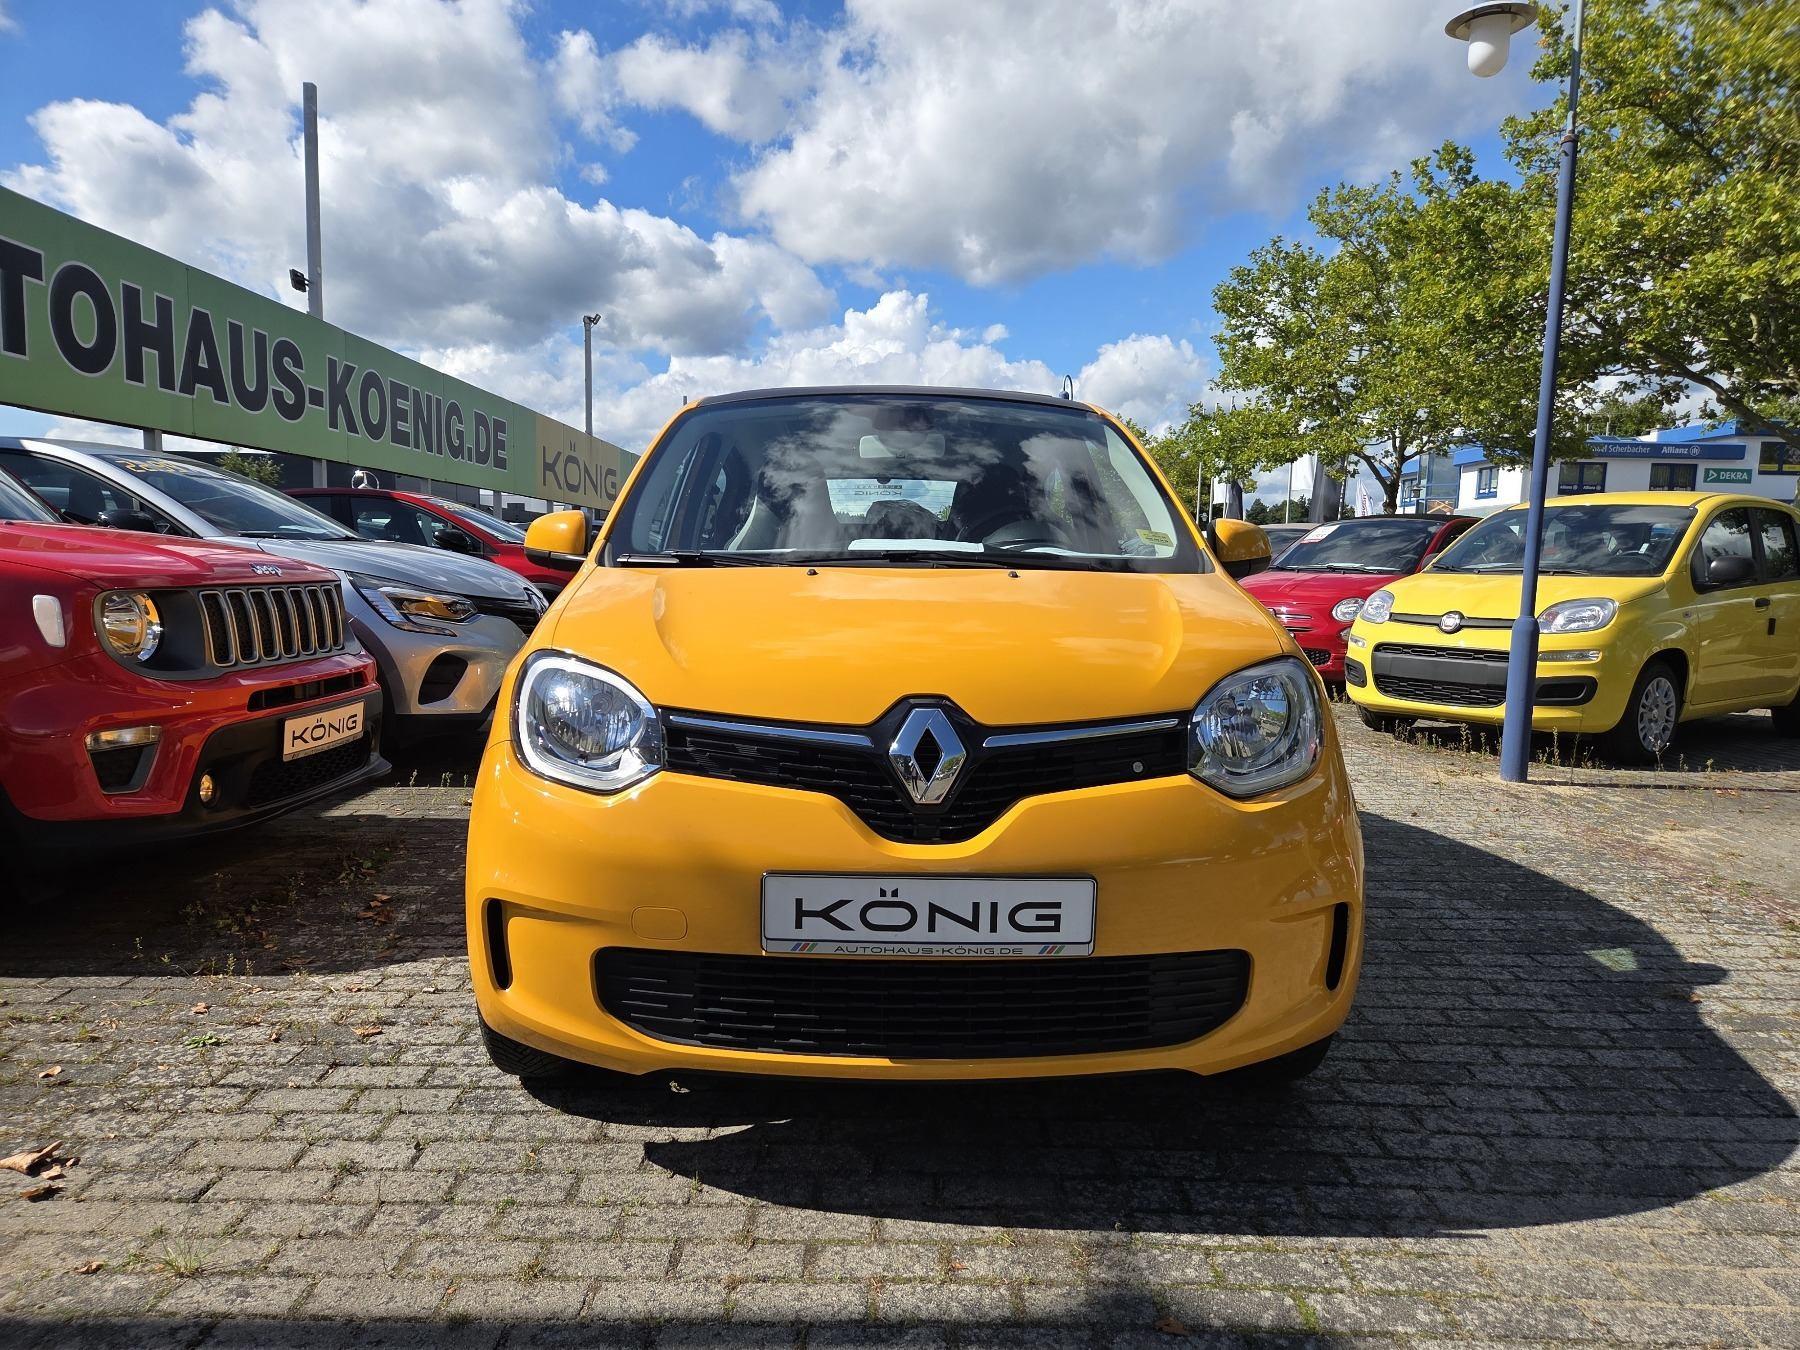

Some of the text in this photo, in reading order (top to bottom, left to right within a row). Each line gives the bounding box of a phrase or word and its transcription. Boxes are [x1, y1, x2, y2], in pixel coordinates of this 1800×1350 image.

[1608, 444, 1650, 455] Scherbacher
[1661, 446, 1688, 454] Allianz
[542, 440, 617, 501] KÖNIG
[1719, 471, 1748, 480] DEKRA
[291, 713, 358, 748] KÖNIG
[795, 887, 1062, 933] KÖNIG
[833, 945, 1024, 955] AUTOHAUS-KÖNIG.DE
